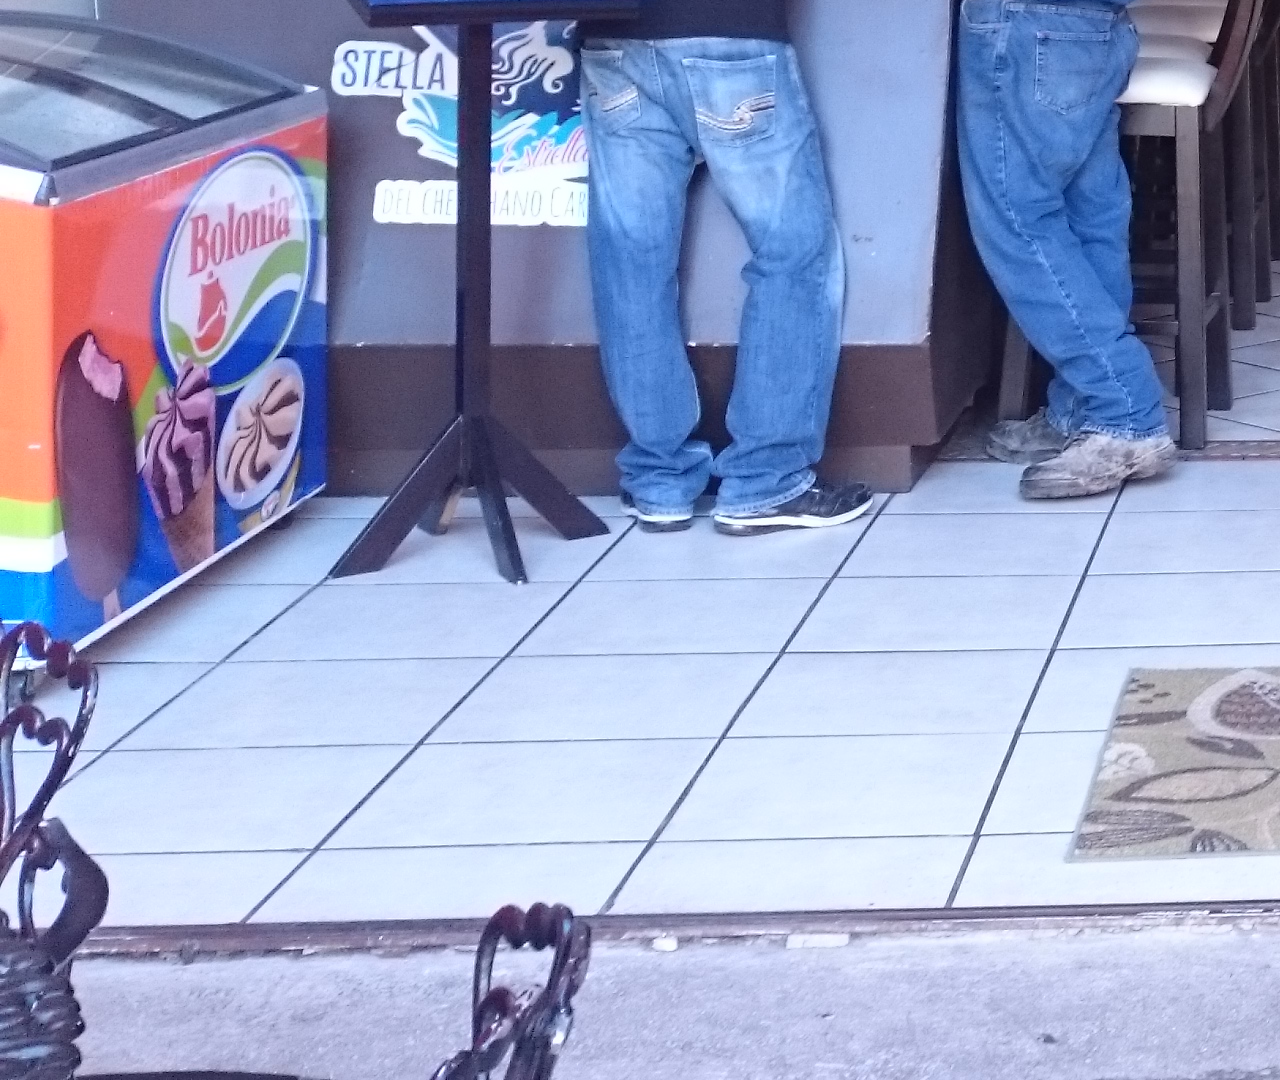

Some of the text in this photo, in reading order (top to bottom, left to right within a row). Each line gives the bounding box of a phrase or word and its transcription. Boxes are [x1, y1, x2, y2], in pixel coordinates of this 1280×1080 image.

[340, 48, 446, 91] STELLA
[495, 125, 589, 176] Estrella
[382, 187, 412, 216] DEL
[421, 187, 457, 217] CHE
[549, 186, 587, 219] CAR
[188, 183, 292, 278] Bolonia
